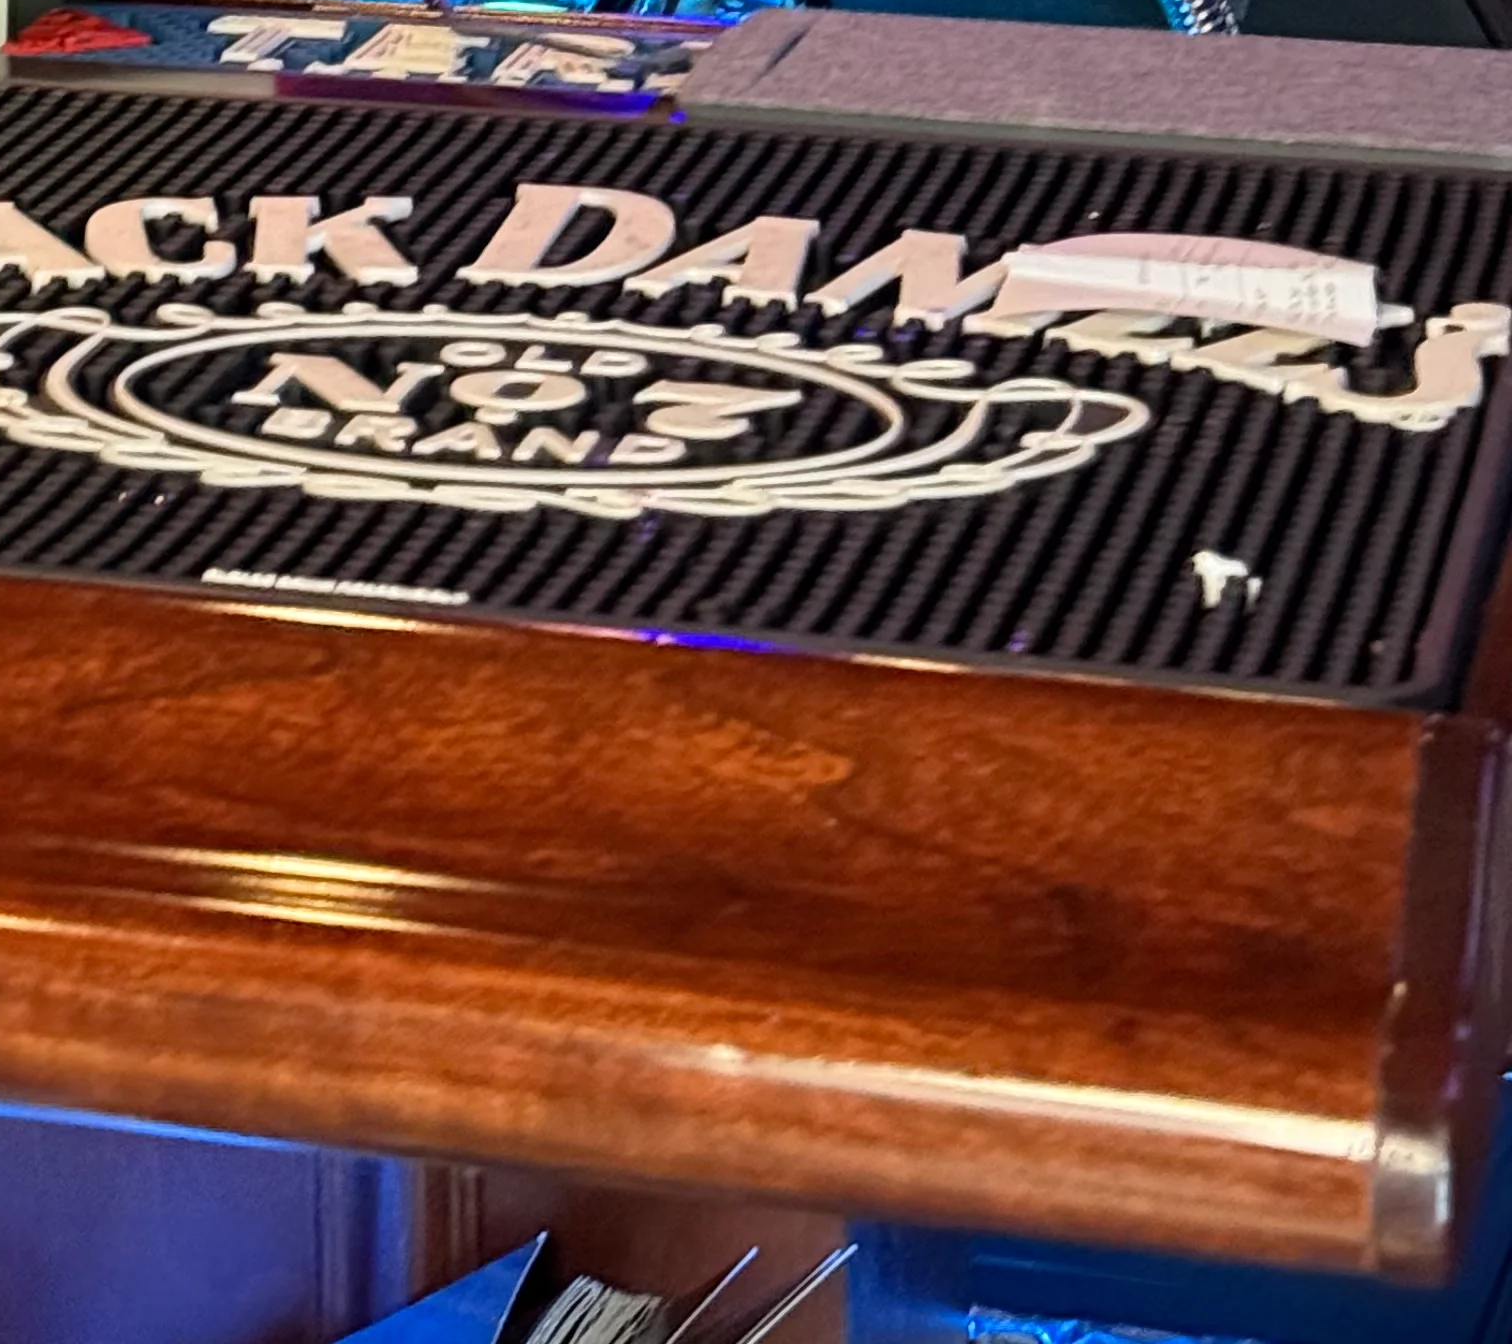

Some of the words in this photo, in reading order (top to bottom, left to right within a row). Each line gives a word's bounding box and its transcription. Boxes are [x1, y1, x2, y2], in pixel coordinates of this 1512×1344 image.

[438, 340, 650, 379] OLD
[259, 406, 688, 465] BRAND
[631, 377, 804, 441] 7
